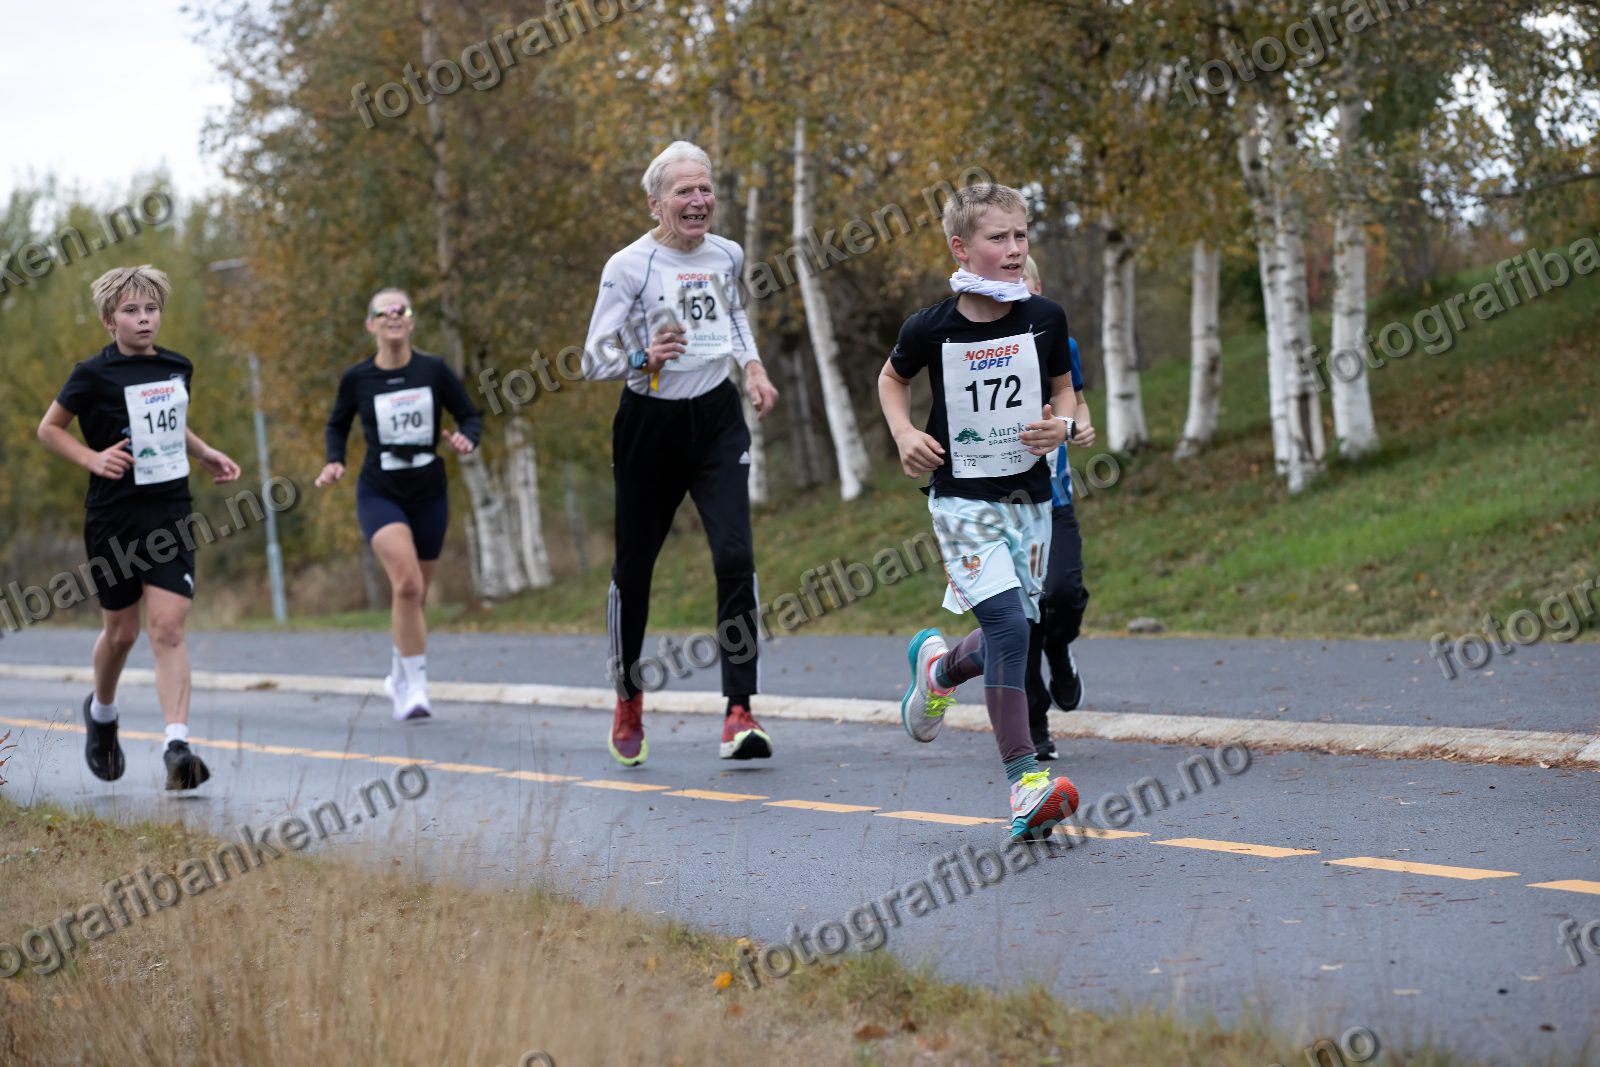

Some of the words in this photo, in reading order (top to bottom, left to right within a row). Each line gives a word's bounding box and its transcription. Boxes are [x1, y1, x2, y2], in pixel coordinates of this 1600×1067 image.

[679, 296, 717, 320] 152
[964, 344, 1020, 361] NORGES
[970, 356, 1012, 371] LØPET
[141, 386, 176, 397] NORGES
[965, 374, 1022, 412] 172
[145, 394, 171, 405] LØPET
[144, 407, 177, 434] 146
[390, 411, 423, 431] 170
[989, 422, 1025, 437] Aursk
[963, 458, 977, 467] 172
[1009, 455, 1022, 464] 172
